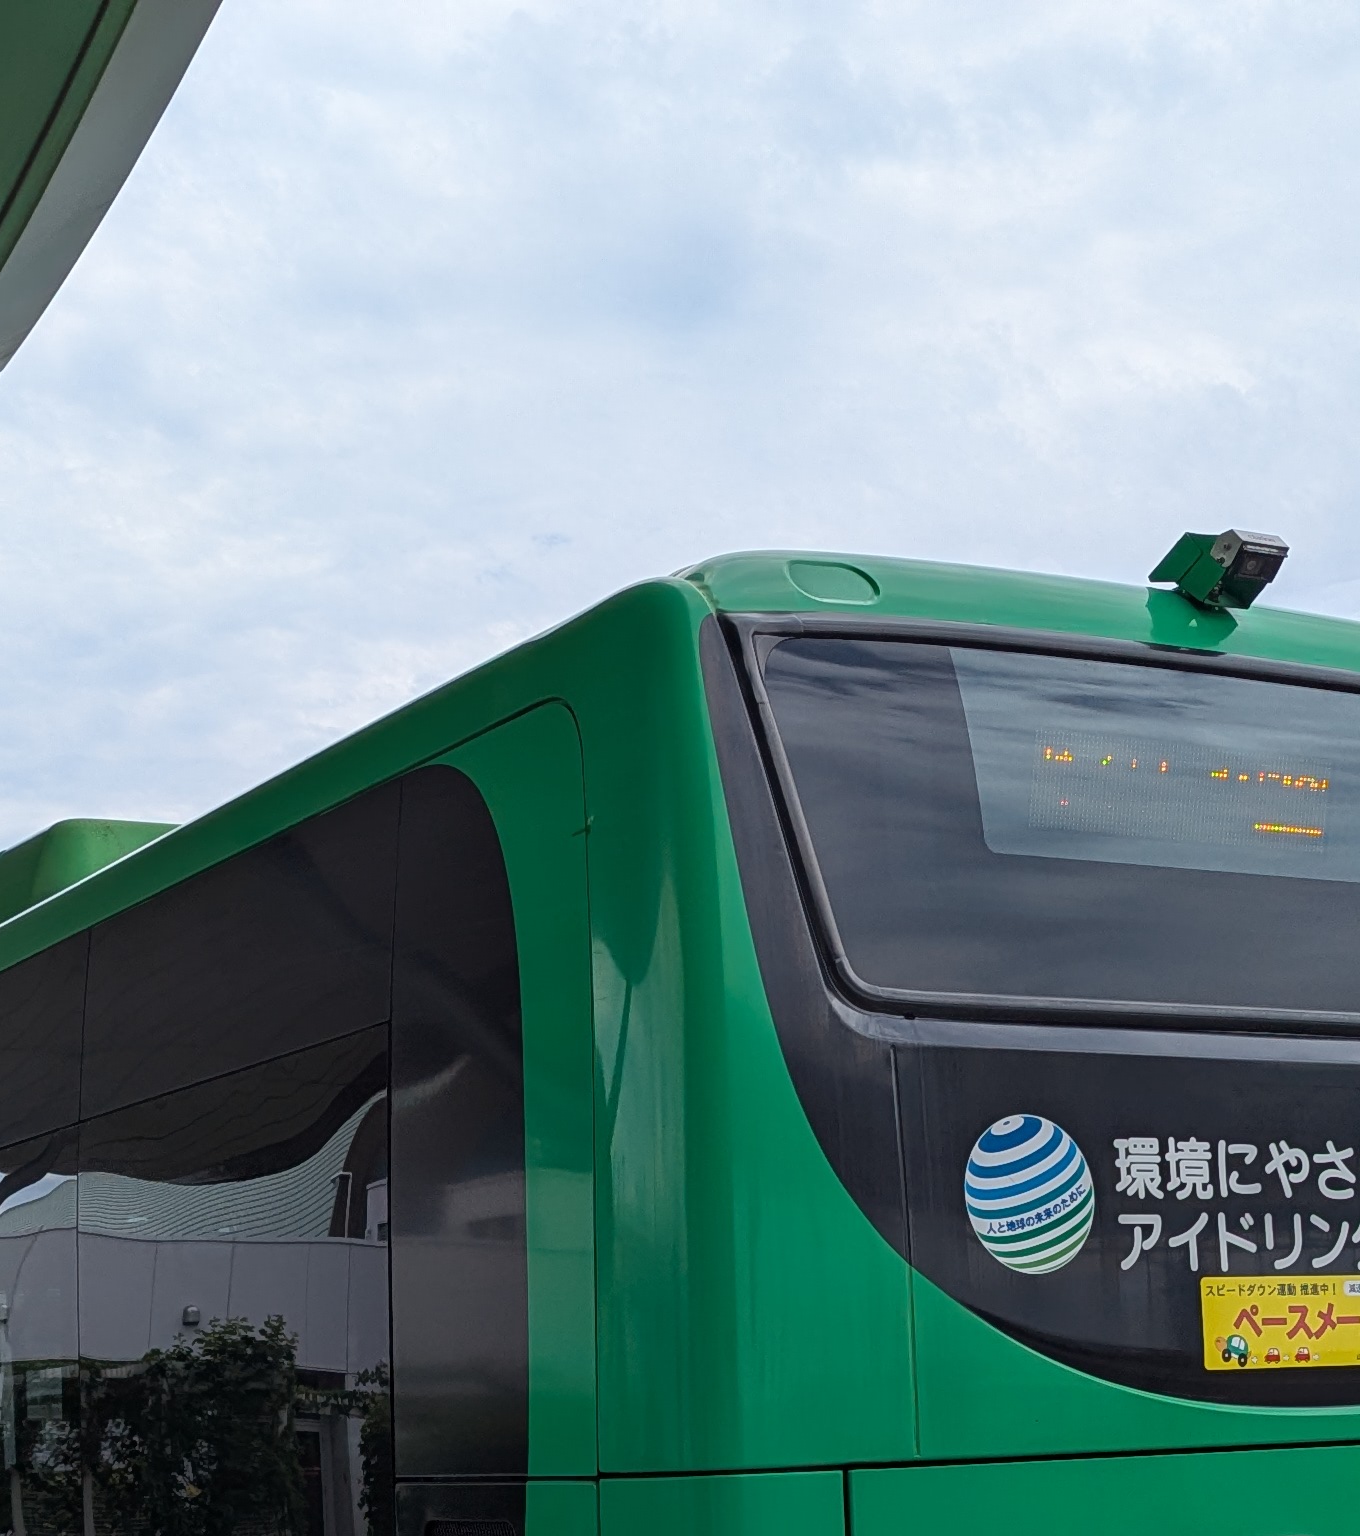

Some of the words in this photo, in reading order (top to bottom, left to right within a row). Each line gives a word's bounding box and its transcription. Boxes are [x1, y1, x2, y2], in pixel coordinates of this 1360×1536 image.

[986, 1183, 1087, 1235] 人と地球の未来のために
